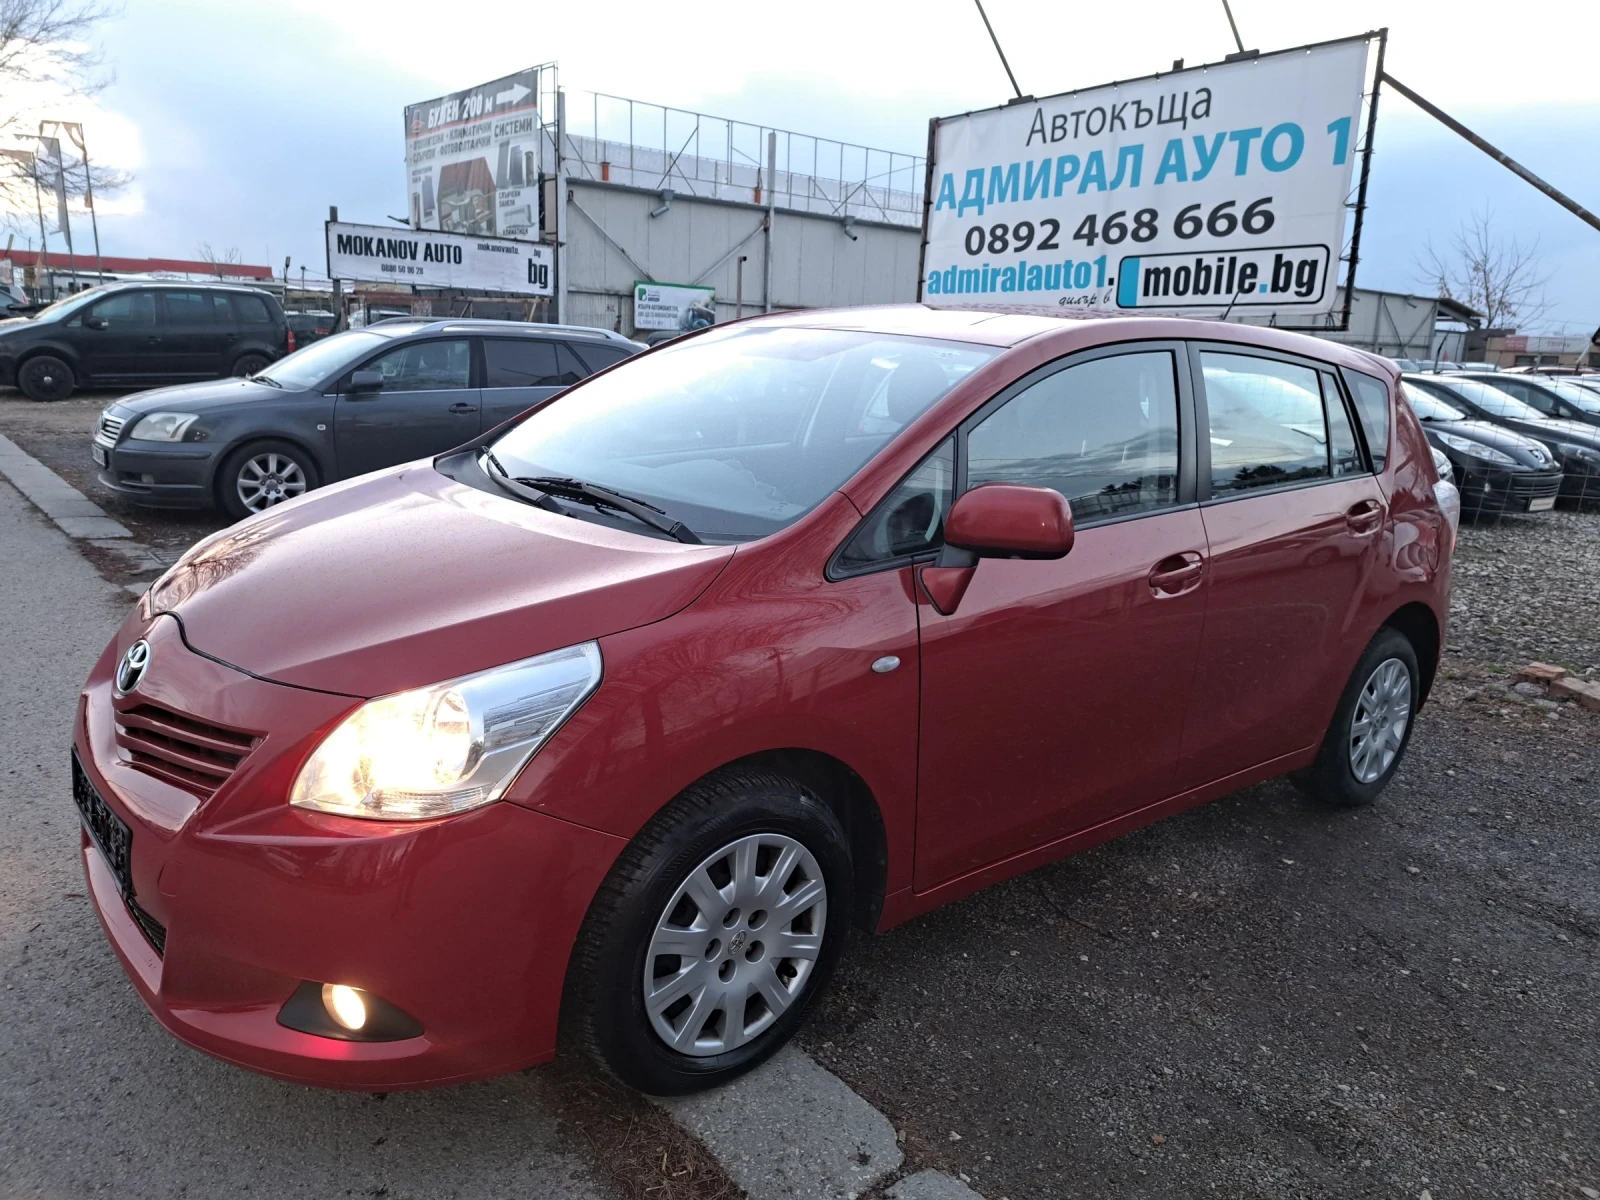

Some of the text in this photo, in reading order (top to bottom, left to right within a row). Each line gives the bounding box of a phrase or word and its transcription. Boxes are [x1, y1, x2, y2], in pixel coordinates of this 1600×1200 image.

[463, 94, 482, 119] 200
[1026, 87, 1212, 147] Автокъща
[494, 117, 532, 138] СИСТЕМИ
[935, 116, 1352, 218] АДМИРАЛ АУТО 1
[965, 197, 1275, 256] 0892 468 666
[337, 234, 462, 264] MOKANOV AUTO
[528, 258, 548, 289] bg
[928, 254, 1318, 298] admiralauto1. mobile.bg
